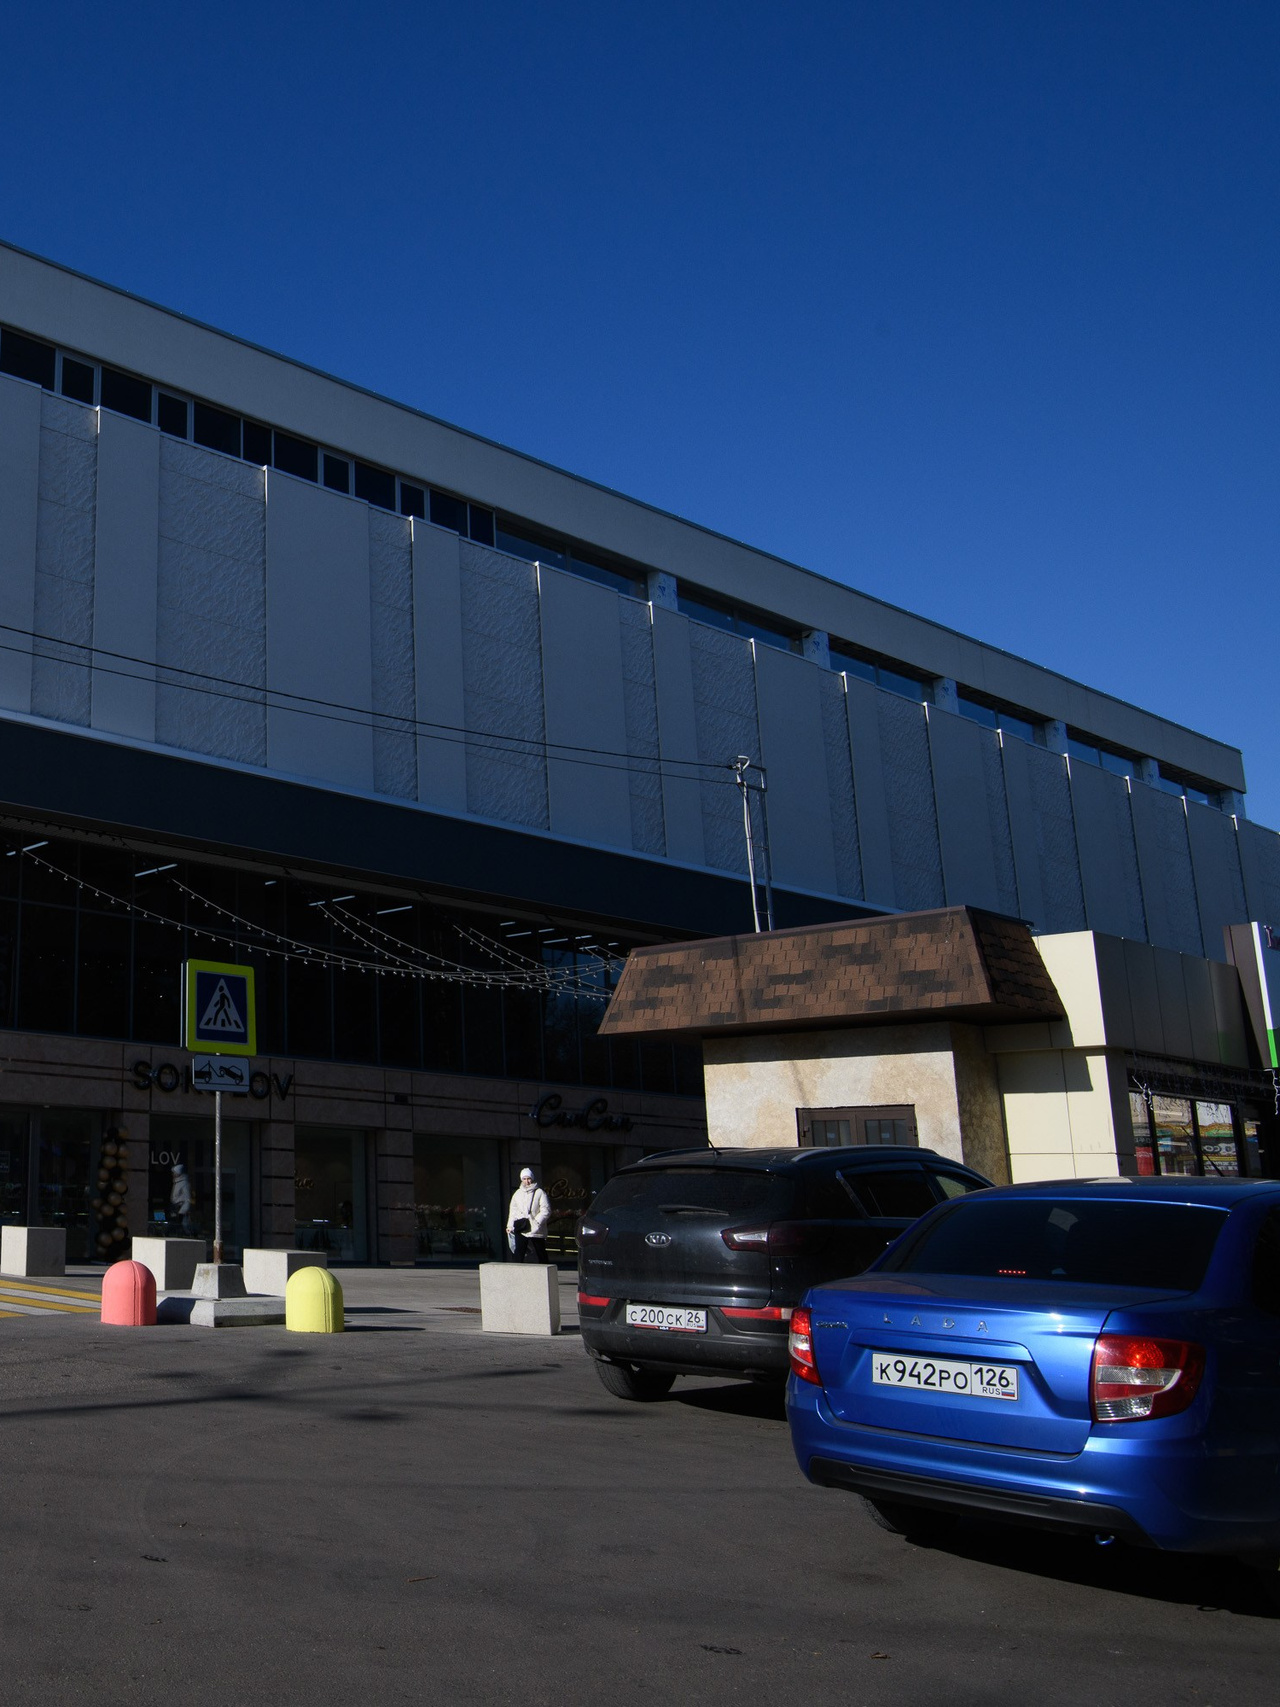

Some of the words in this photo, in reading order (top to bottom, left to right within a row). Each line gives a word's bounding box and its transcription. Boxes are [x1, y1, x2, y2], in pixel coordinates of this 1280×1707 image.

[648, 1233, 668, 1245] KIA
[687, 1311, 701, 1324] 26
[883, 1312, 989, 1333] LADA
[973, 1366, 1010, 1388] 126
[982, 1387, 1000, 1396] RUS
